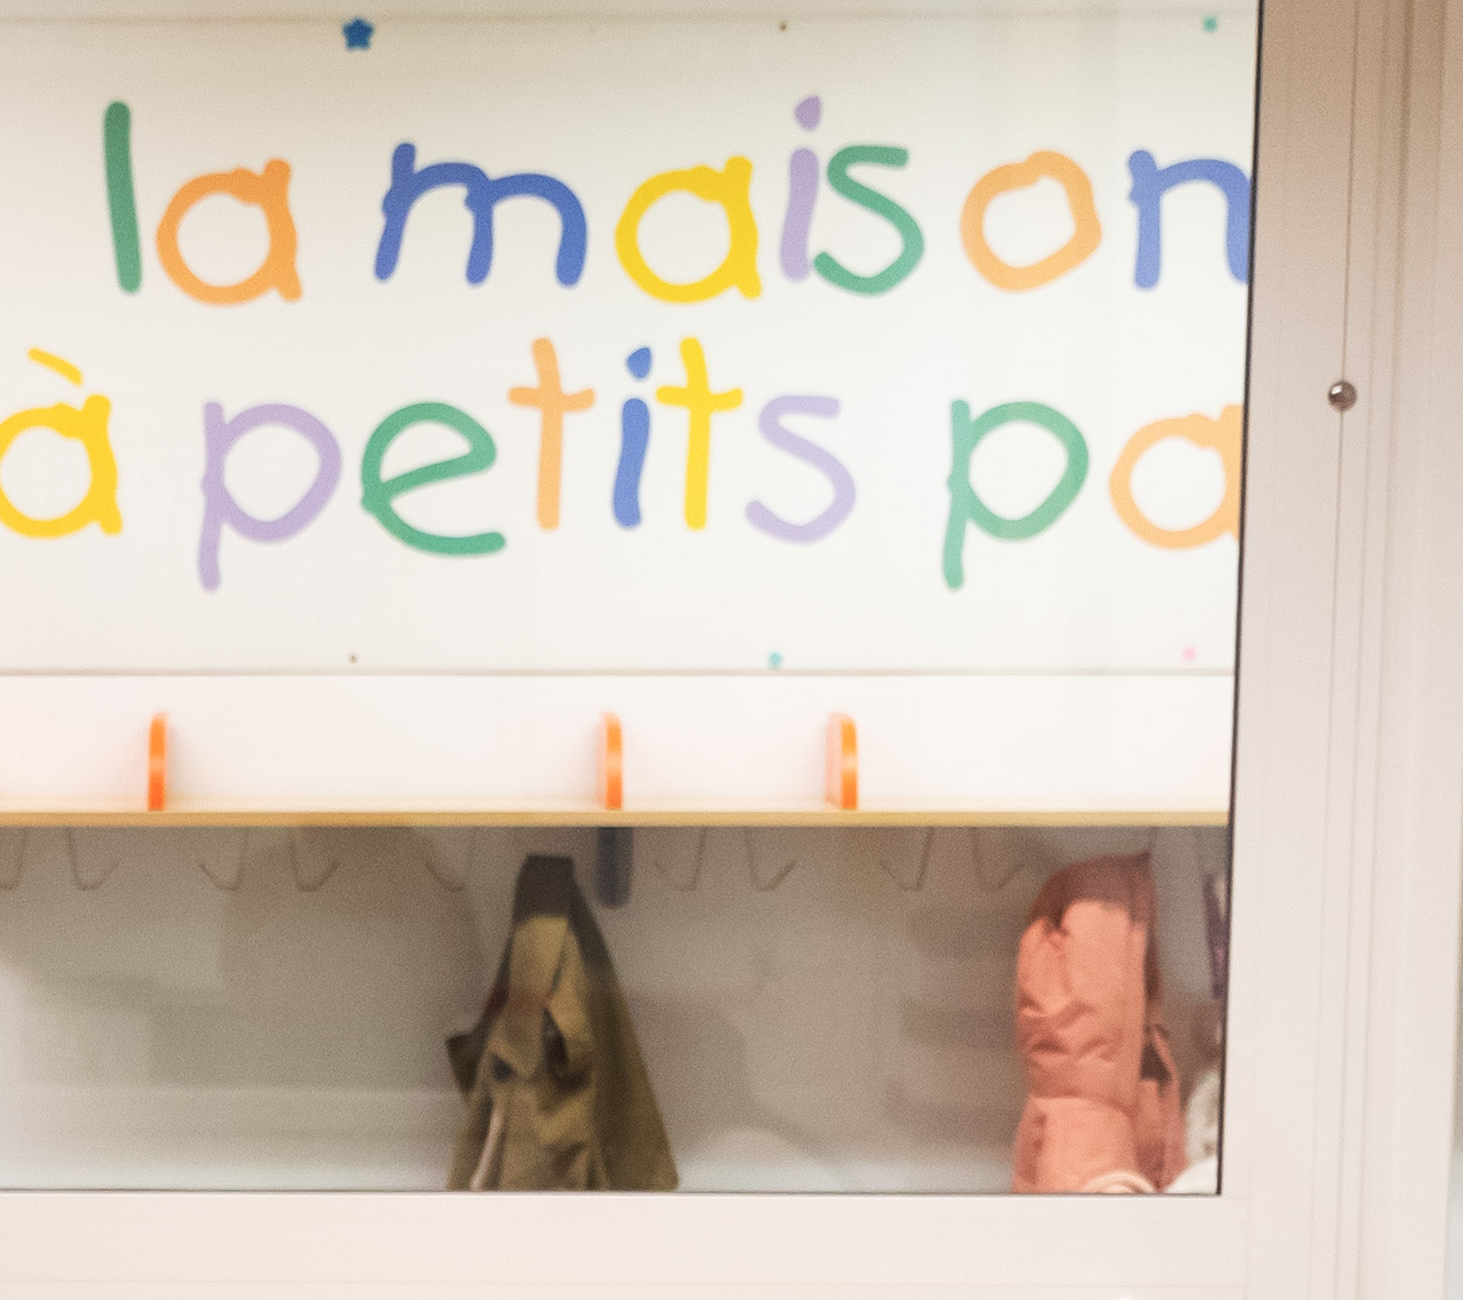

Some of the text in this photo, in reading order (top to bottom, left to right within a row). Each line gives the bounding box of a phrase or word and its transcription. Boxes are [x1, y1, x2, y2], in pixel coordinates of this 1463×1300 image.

[103, 96, 1253, 306] la maison
[198, 337, 859, 592] petits
[942, 397, 1244, 592] pa
